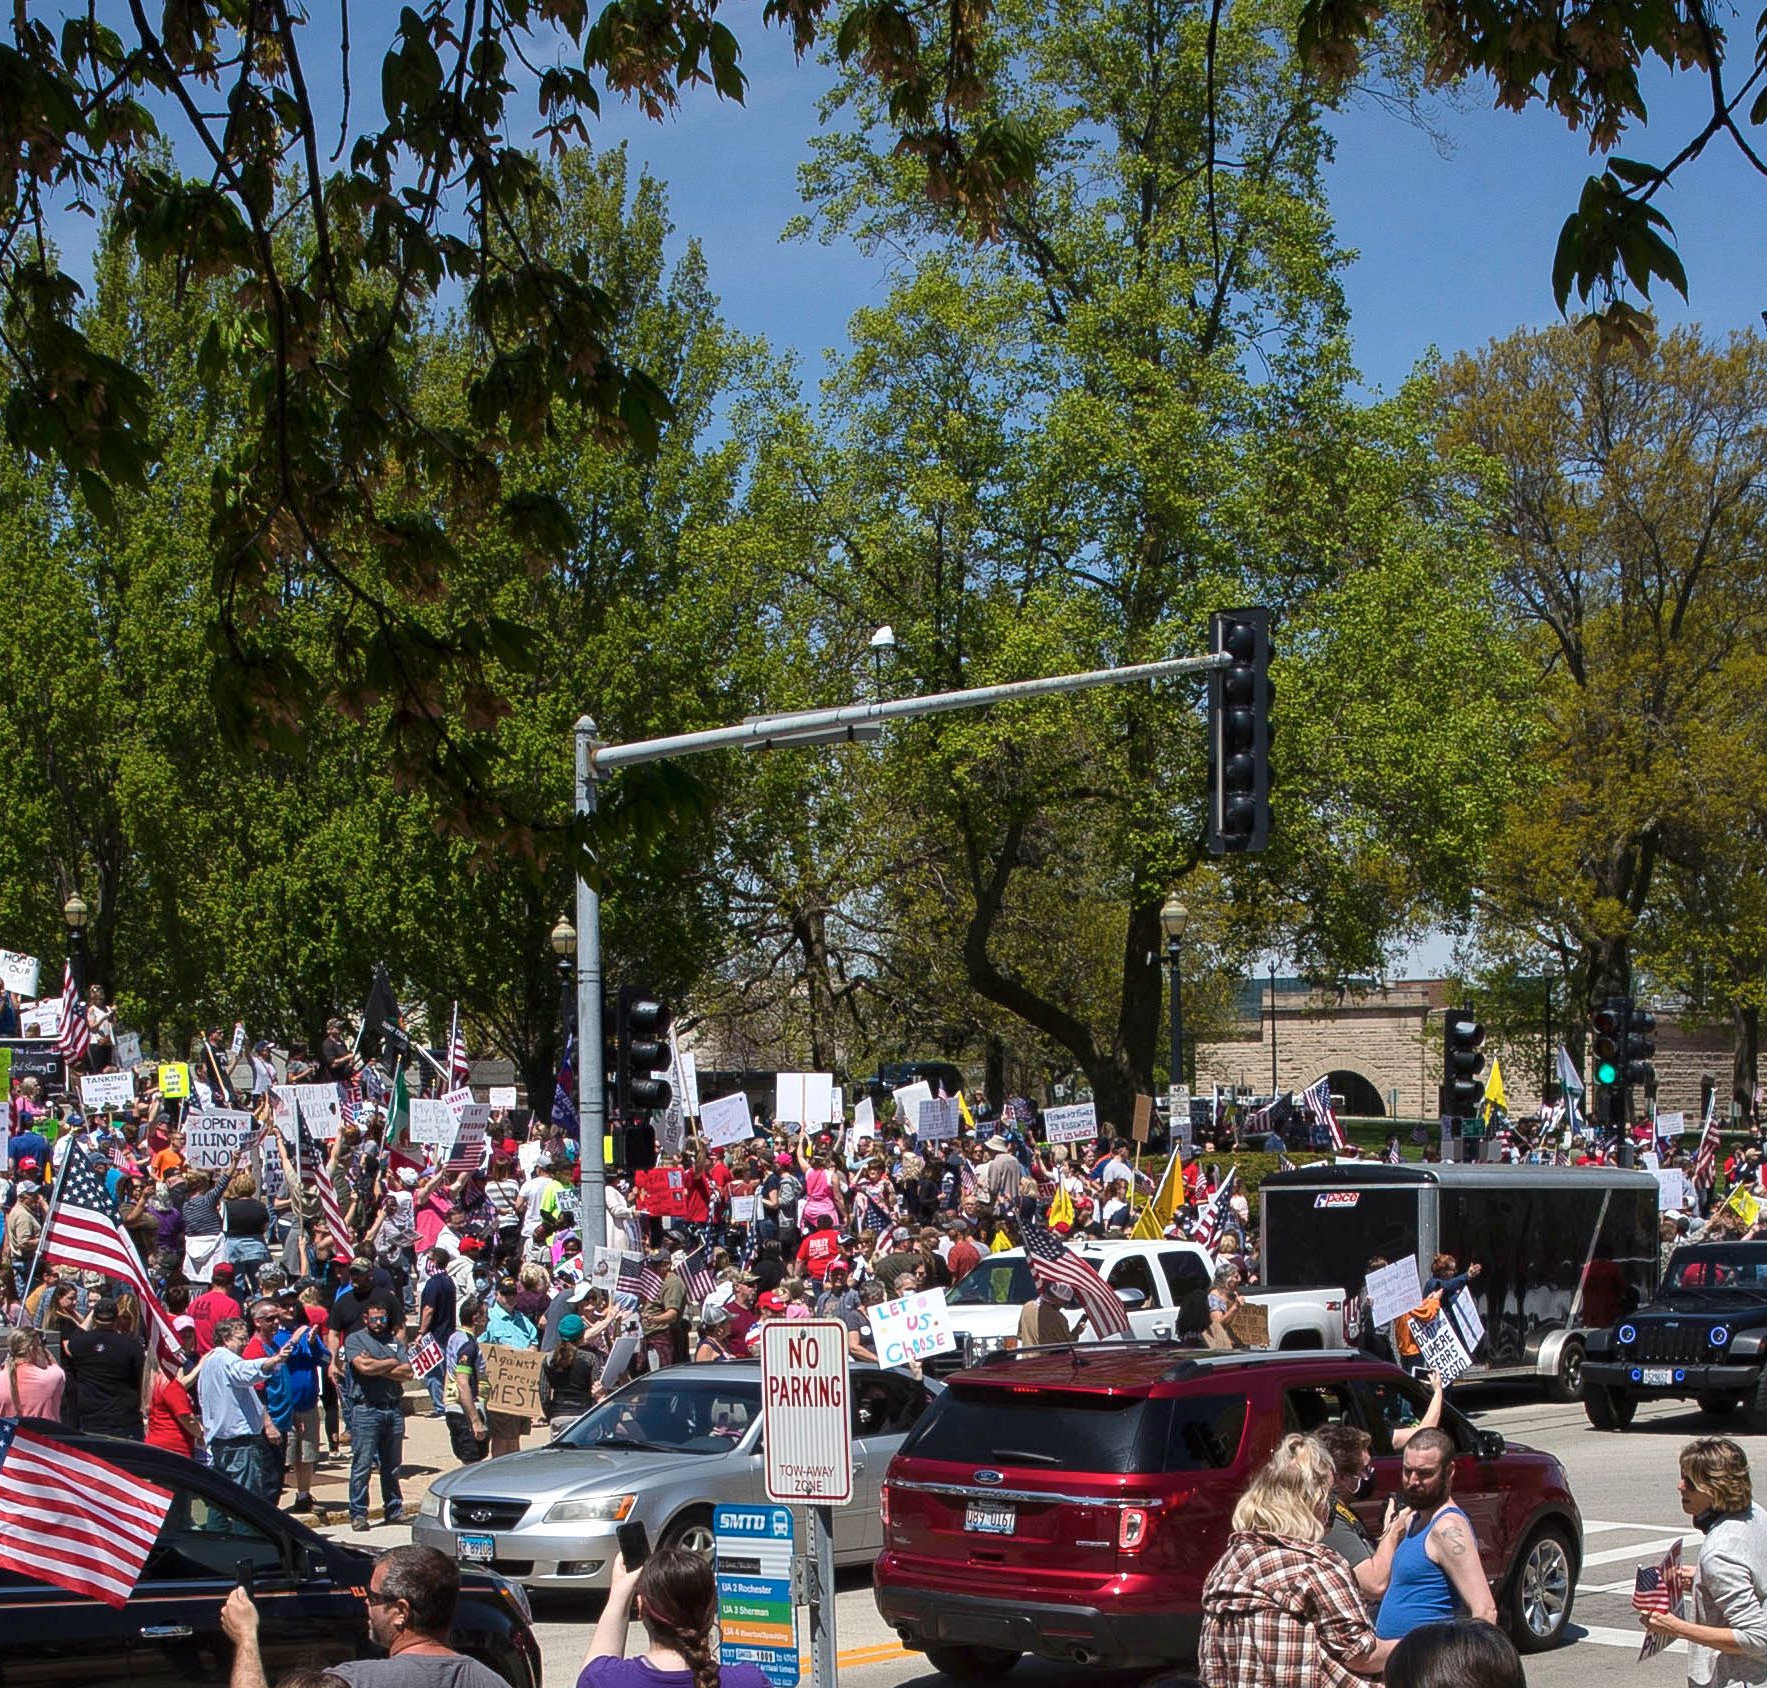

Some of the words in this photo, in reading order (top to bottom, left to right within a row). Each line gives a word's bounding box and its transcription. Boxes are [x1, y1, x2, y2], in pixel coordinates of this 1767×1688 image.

[85, 1074, 128, 1086] TANKING
[201, 1118, 237, 1131] OPEN
[190, 1132, 238, 1149] ILLINO
[1049, 1133, 1062, 1142] LET
[202, 1149, 235, 1168] NO
[876, 1298, 909, 1320] LET
[906, 1313, 933, 1332] US
[787, 1336, 821, 1370] NO
[1423, 1328, 1455, 1362] WHERE
[412, 1341, 443, 1378] FIRE
[1429, 1347, 1459, 1372] FEARS
[1440, 1356, 1469, 1386] BEGIN
[769, 1374, 842, 1409] PARKING
[779, 1463, 836, 1479] TOW-AWAY
[793, 1478, 824, 1494] ZONE
[719, 1513, 766, 1530] SMTD
[722, 1582, 731, 1592] UA
[732, 1583, 738, 1593] 2
[738, 1583, 773, 1594] Rochester
[723, 1604, 733, 1614] UA
[733, 1605, 738, 1615] 3
[739, 1605, 770, 1617] Sherman
[724, 1626, 734, 1636] UA
[735, 1628, 741, 1637] 4
[721, 1647, 735, 1658] TEXT
